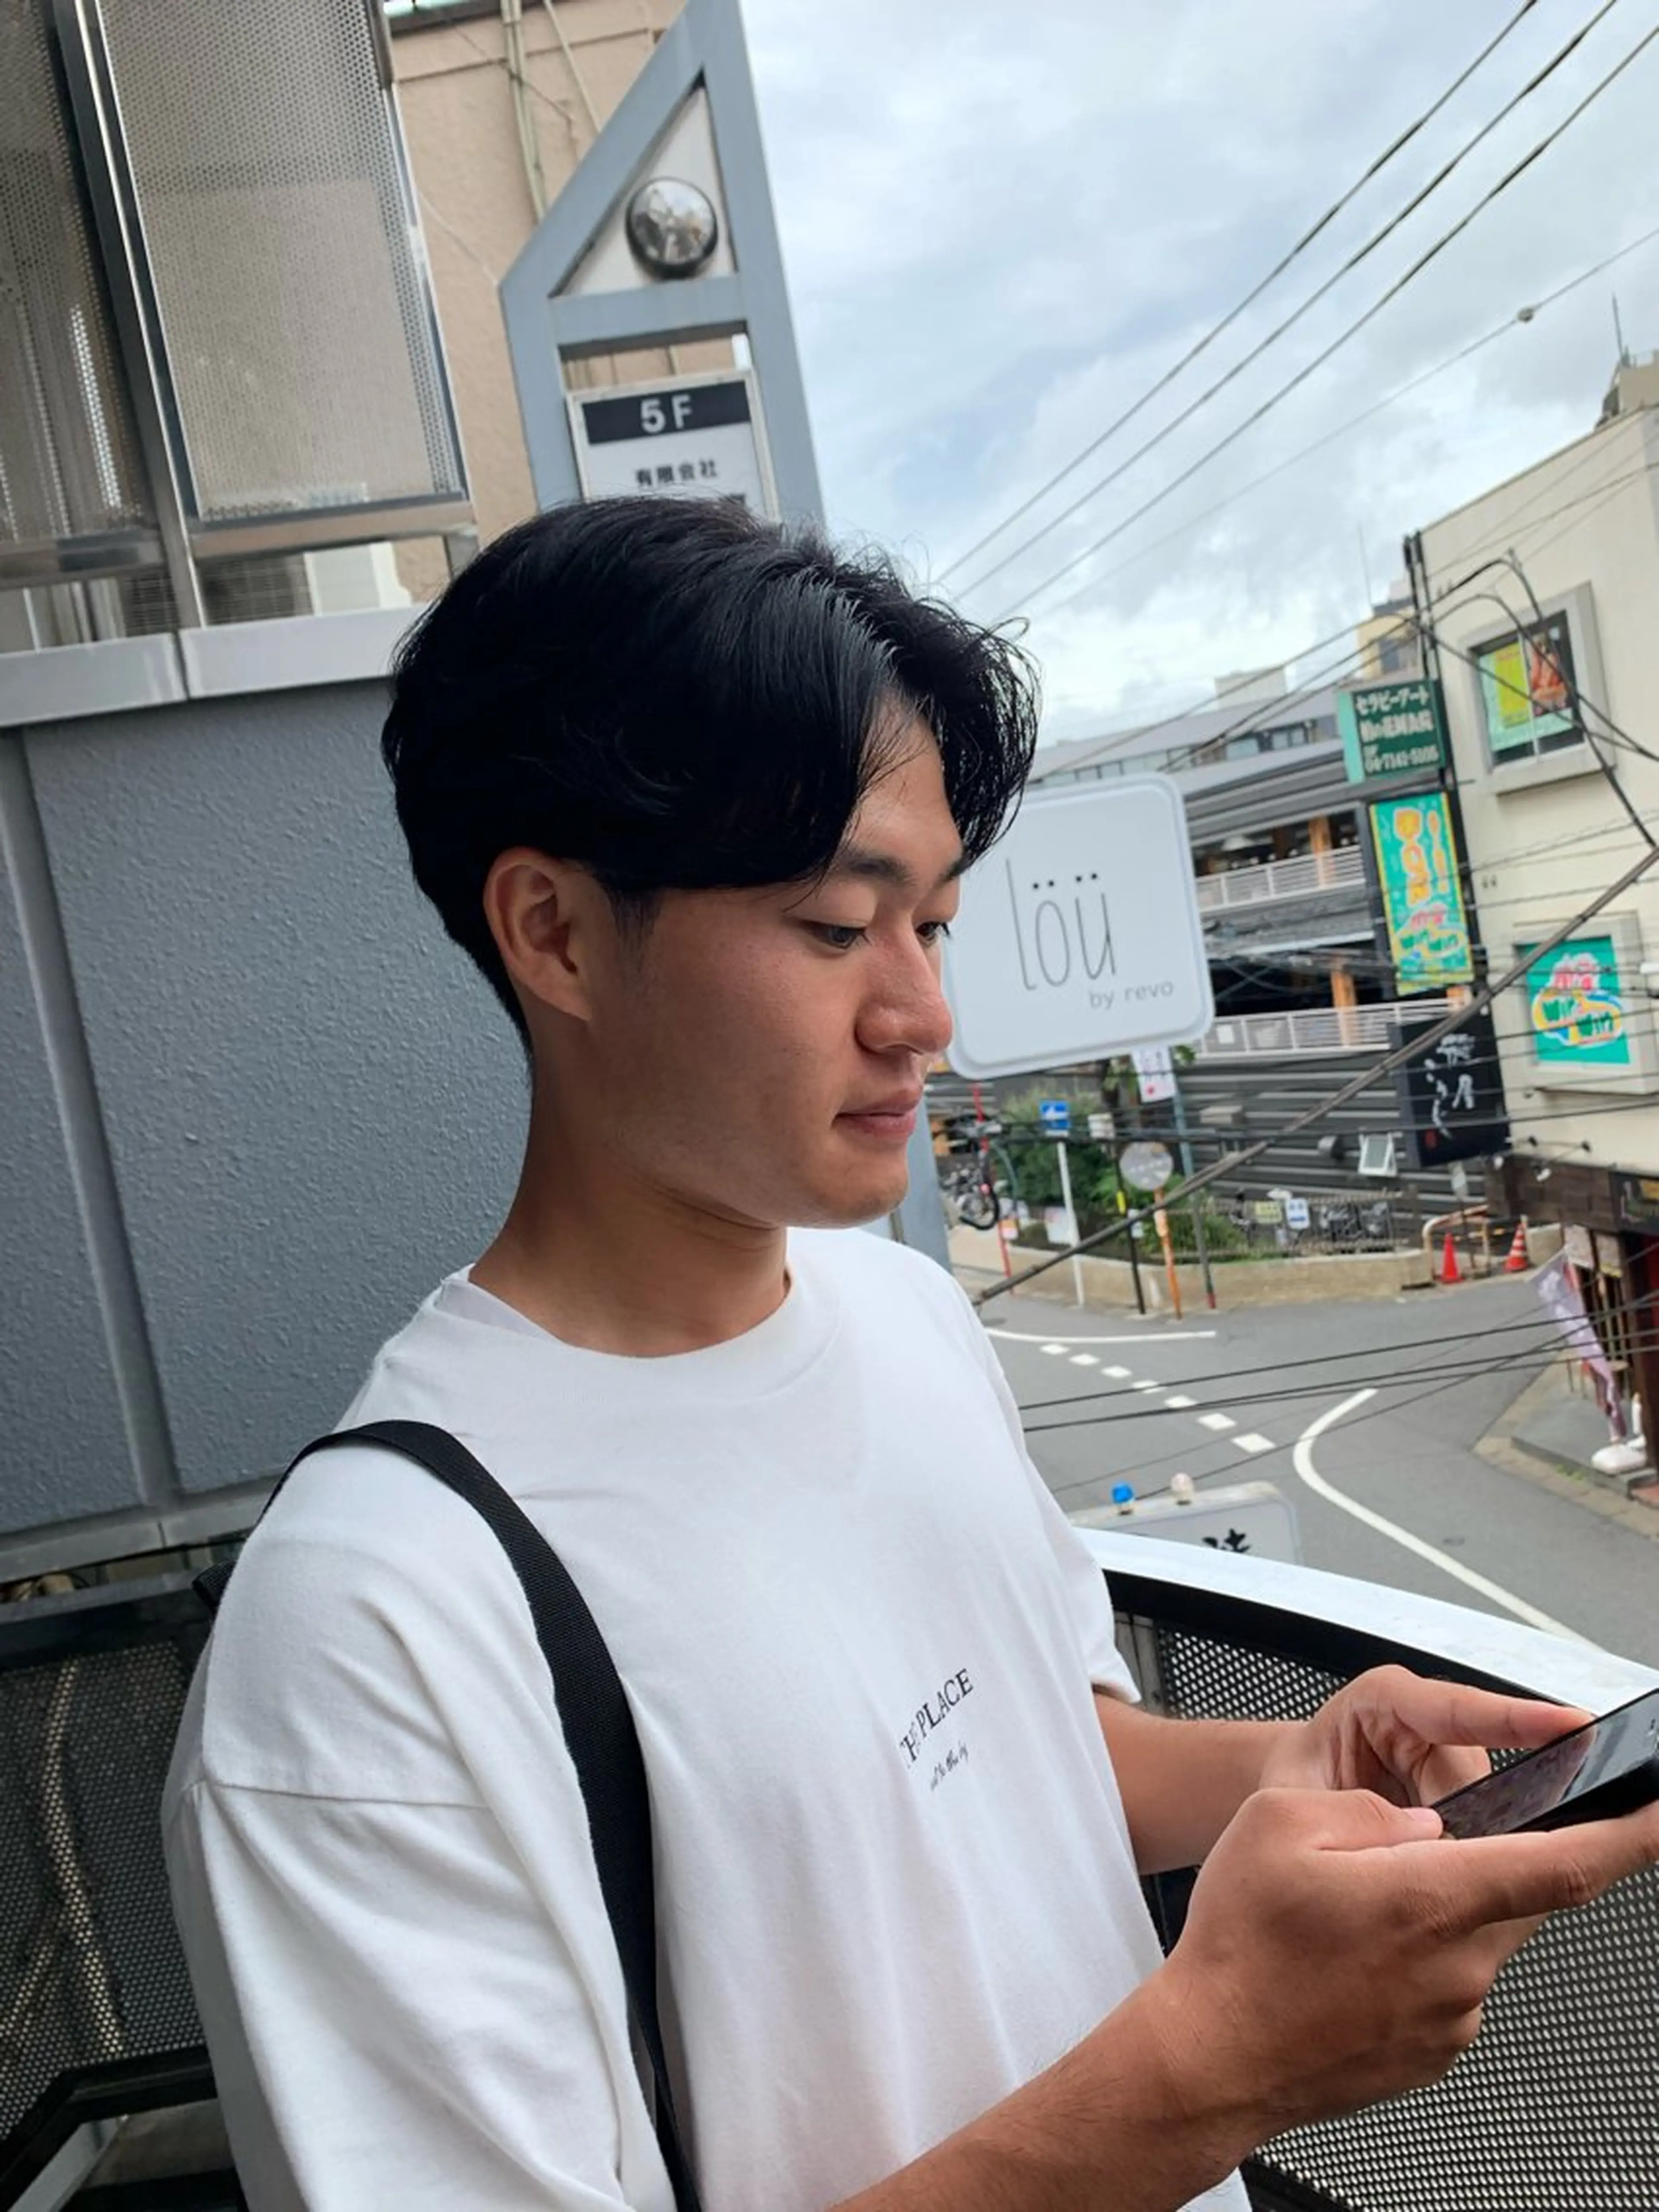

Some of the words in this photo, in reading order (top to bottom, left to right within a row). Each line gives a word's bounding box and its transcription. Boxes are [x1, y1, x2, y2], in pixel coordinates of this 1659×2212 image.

[640, 393, 692, 433] 5F
[636, 458, 718, 486] 有限会社
[1088, 989, 1115, 1010] by
[1124, 981, 1174, 1001] revo
[915, 1668, 974, 1739] PLACE
